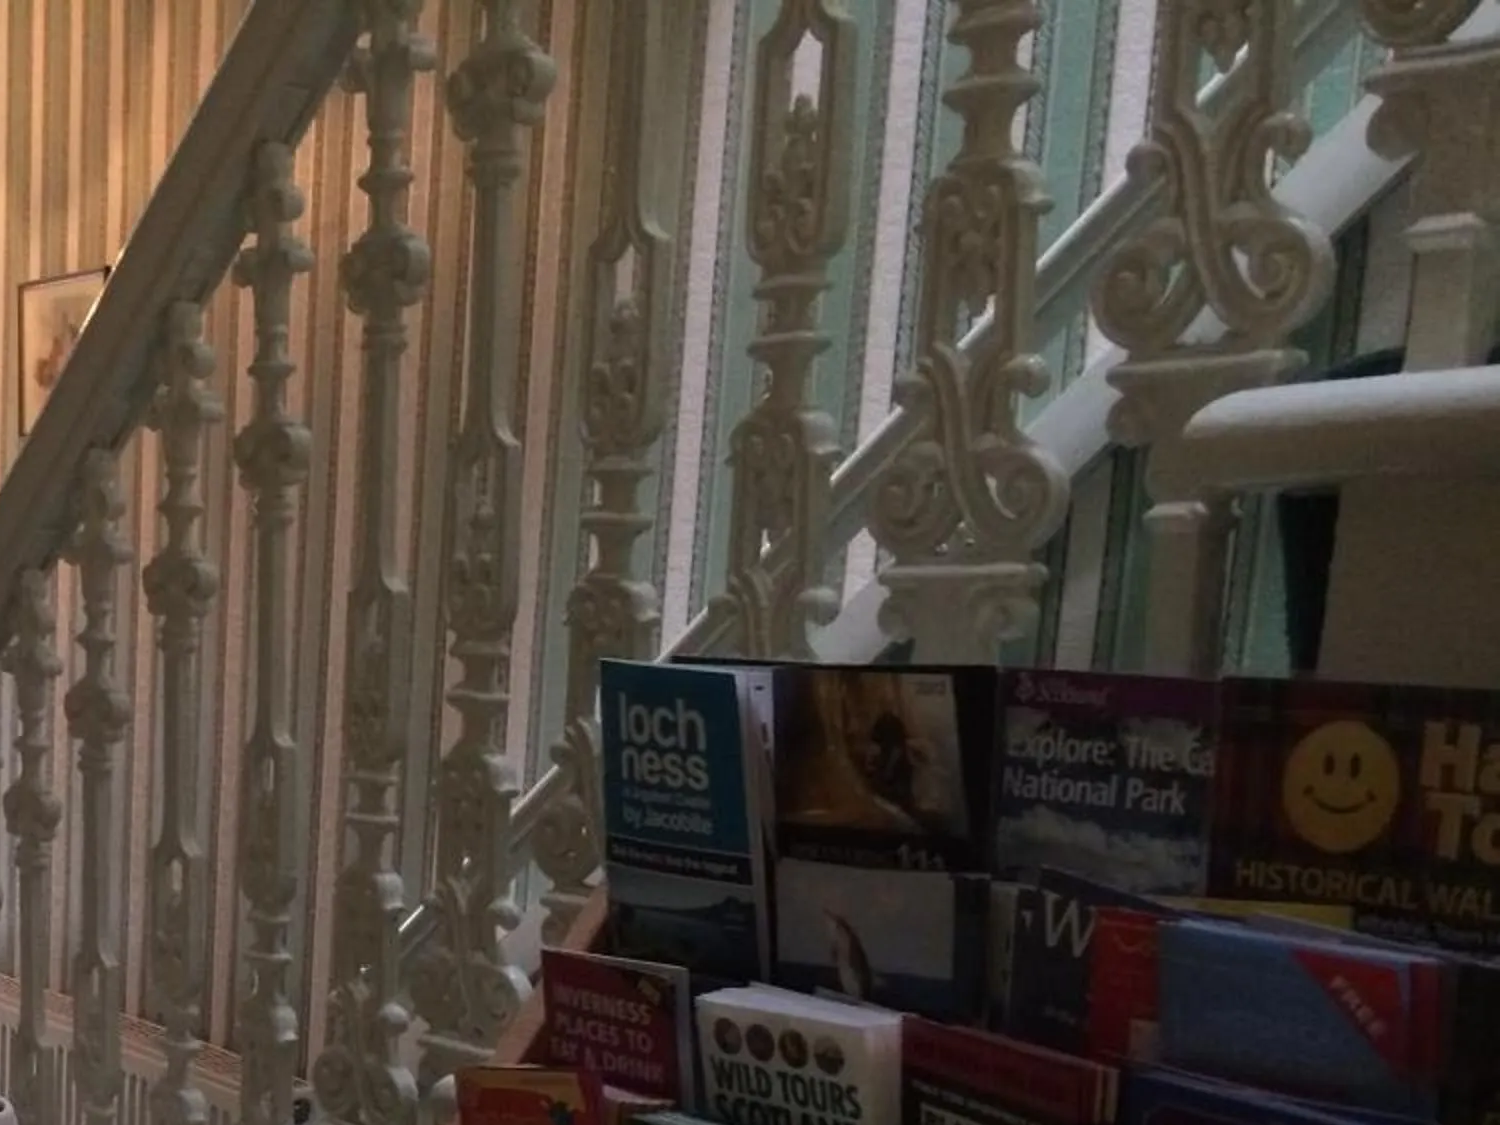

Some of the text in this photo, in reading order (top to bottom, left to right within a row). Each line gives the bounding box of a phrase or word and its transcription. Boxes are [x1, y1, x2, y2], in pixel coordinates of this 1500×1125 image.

[618, 691, 707, 751] loch
[620, 746, 709, 792] ness
[1007, 725, 1115, 769] Explore:
[1126, 735, 1175, 770] The
[1003, 766, 1187, 816] National Park
[1235, 858, 1418, 910] HISTORICAL
[554, 1012, 651, 1052] PLACES TO
[711, 1056, 772, 1099] WILD
[777, 1070, 863, 1120] TOURS
